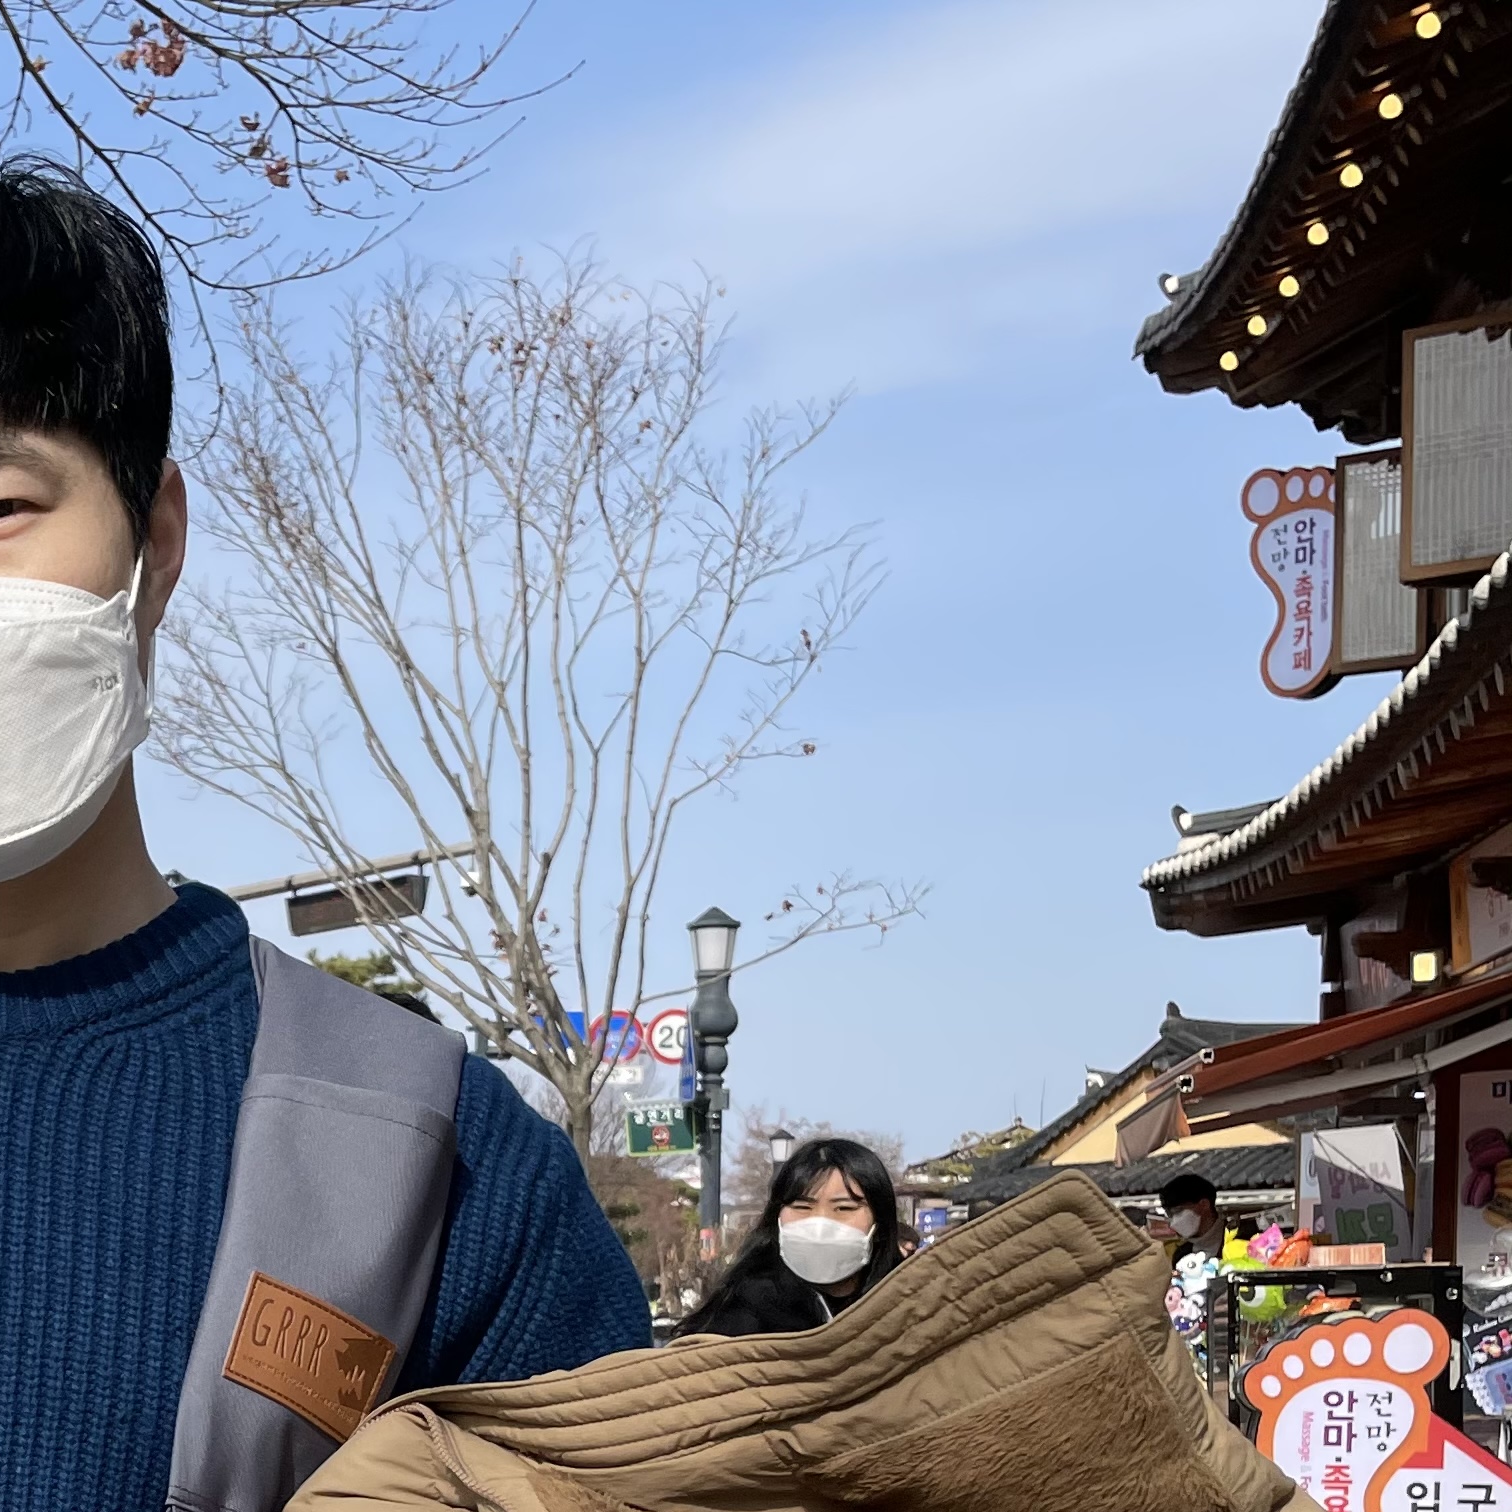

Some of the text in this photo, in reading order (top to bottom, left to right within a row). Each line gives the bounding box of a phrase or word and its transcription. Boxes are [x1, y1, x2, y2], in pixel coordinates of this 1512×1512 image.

[251, 1298, 331, 1378] GRRR
[1298, 1411, 1314, 1463] Massage
[1366, 1391, 1397, 1452] 전망
